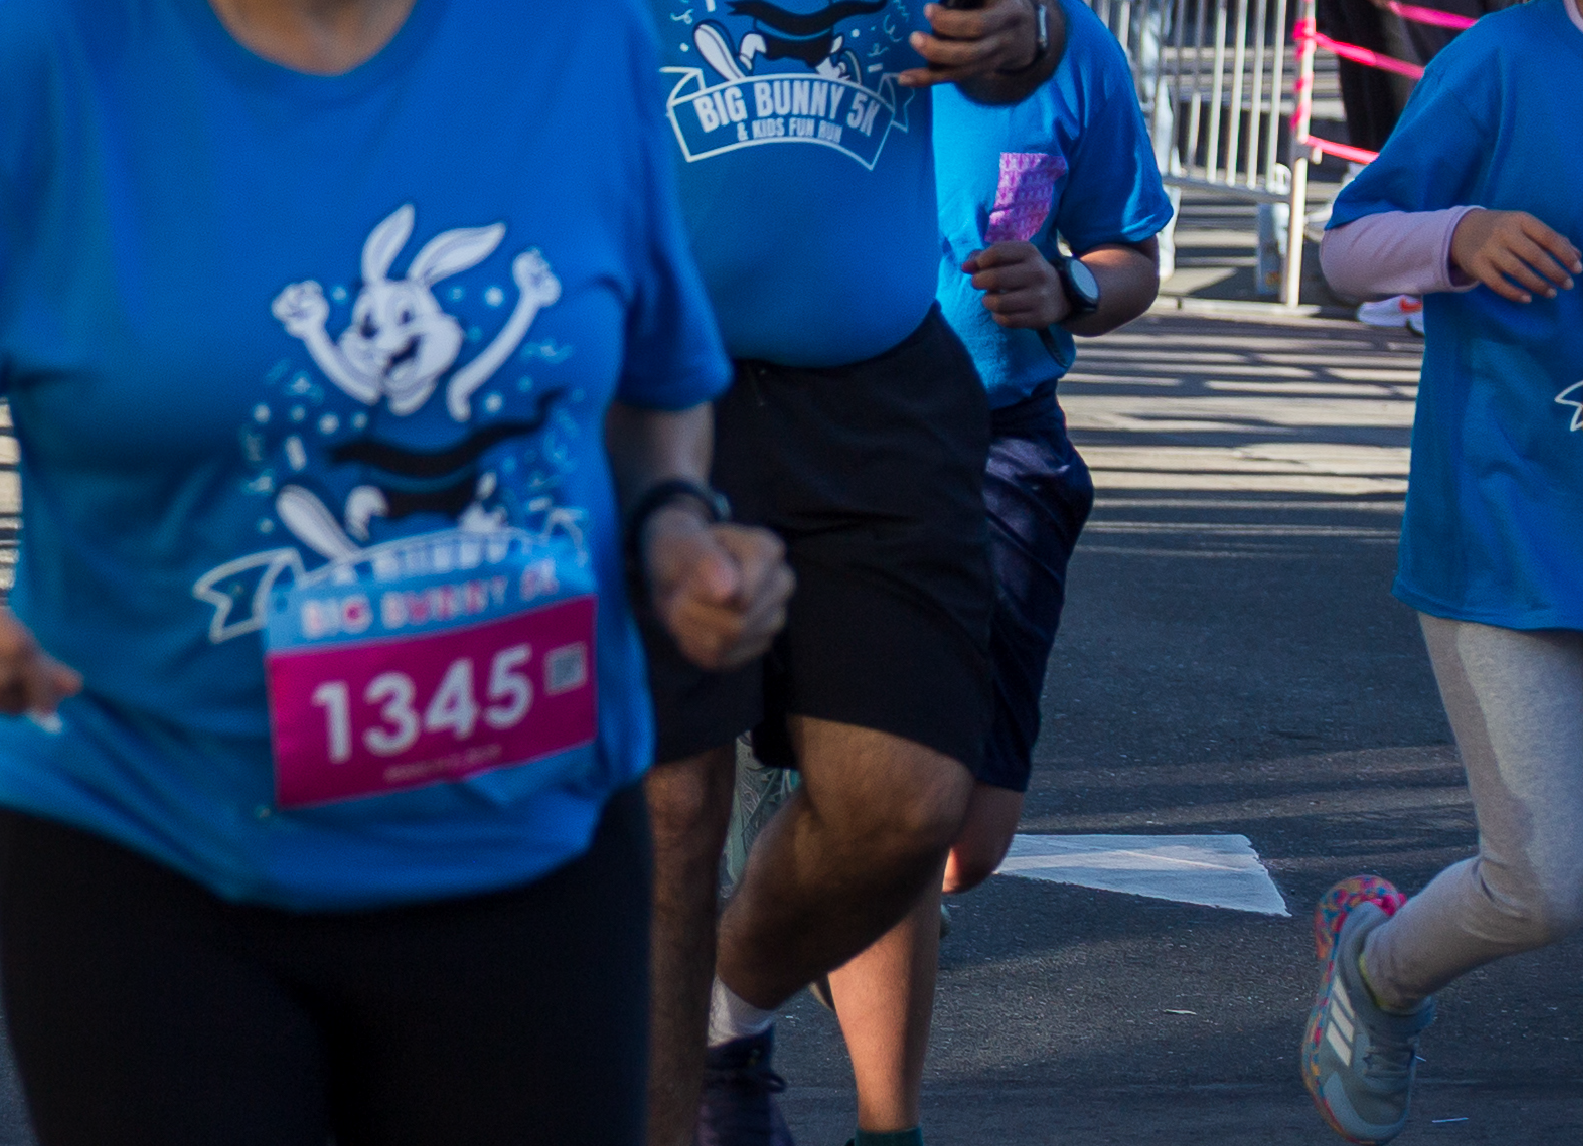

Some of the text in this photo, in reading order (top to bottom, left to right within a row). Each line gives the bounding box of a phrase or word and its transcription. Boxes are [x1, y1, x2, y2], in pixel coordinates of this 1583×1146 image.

[692, 80, 881, 137] BIG BUNNY 5K
[737, 117, 843, 145] & KIDS FUN RUN
[311, 643, 534, 765] 1345
